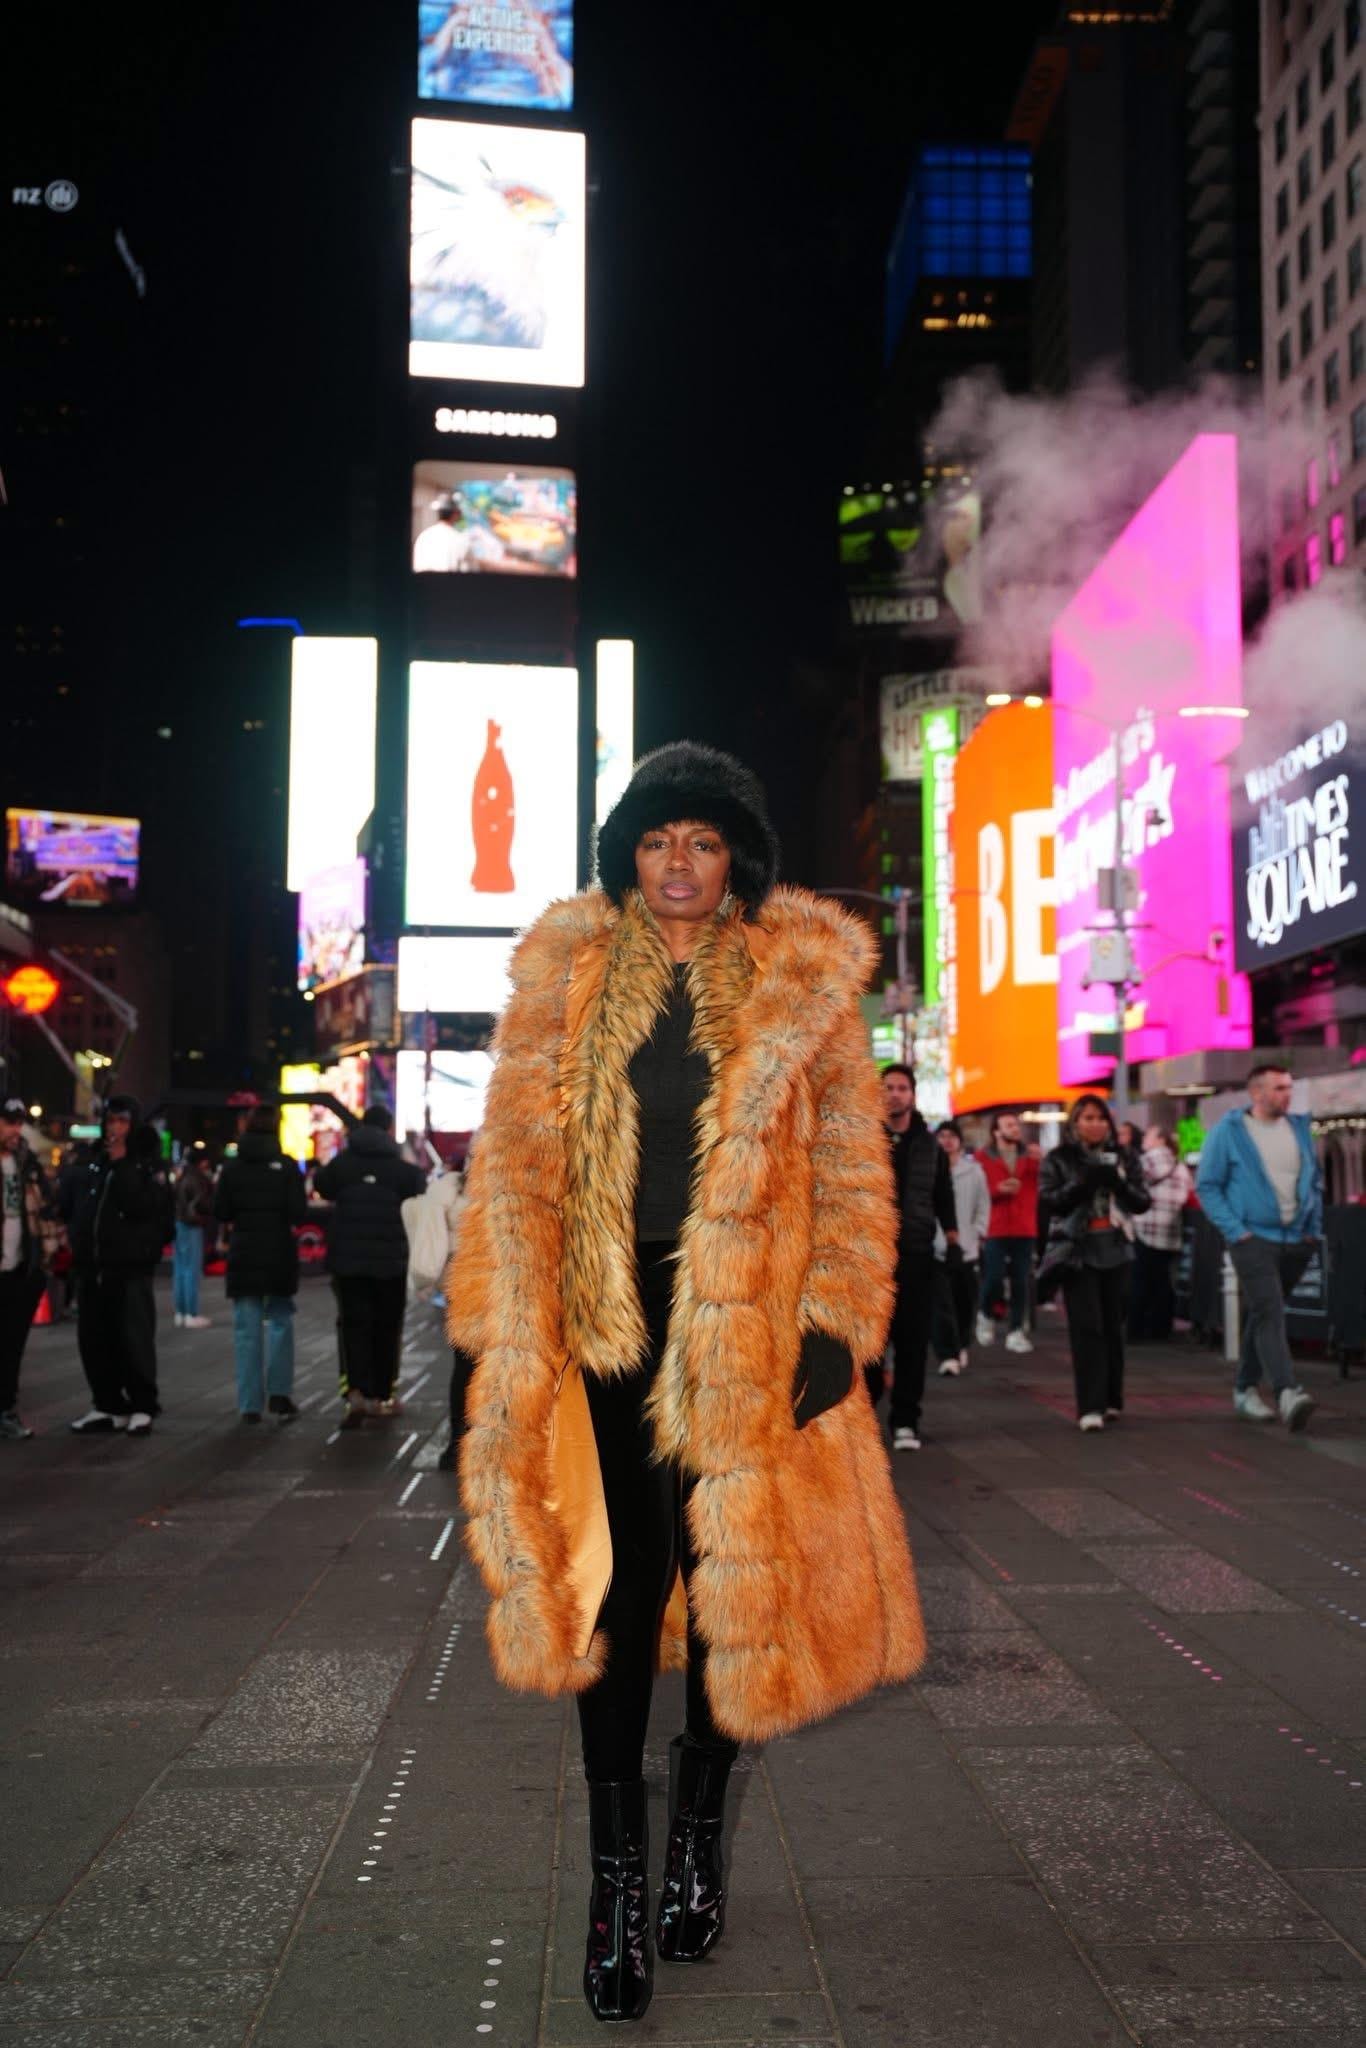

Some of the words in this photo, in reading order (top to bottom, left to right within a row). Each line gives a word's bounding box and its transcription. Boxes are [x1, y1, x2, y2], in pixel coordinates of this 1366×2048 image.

[434, 406, 558, 439] SAMSUNG
[1244, 733, 1322, 804] WELCOME
[1322, 719, 1348, 758] TO
[1284, 774, 1349, 849] TIMES
[1247, 826, 1358, 949] SQUARE
